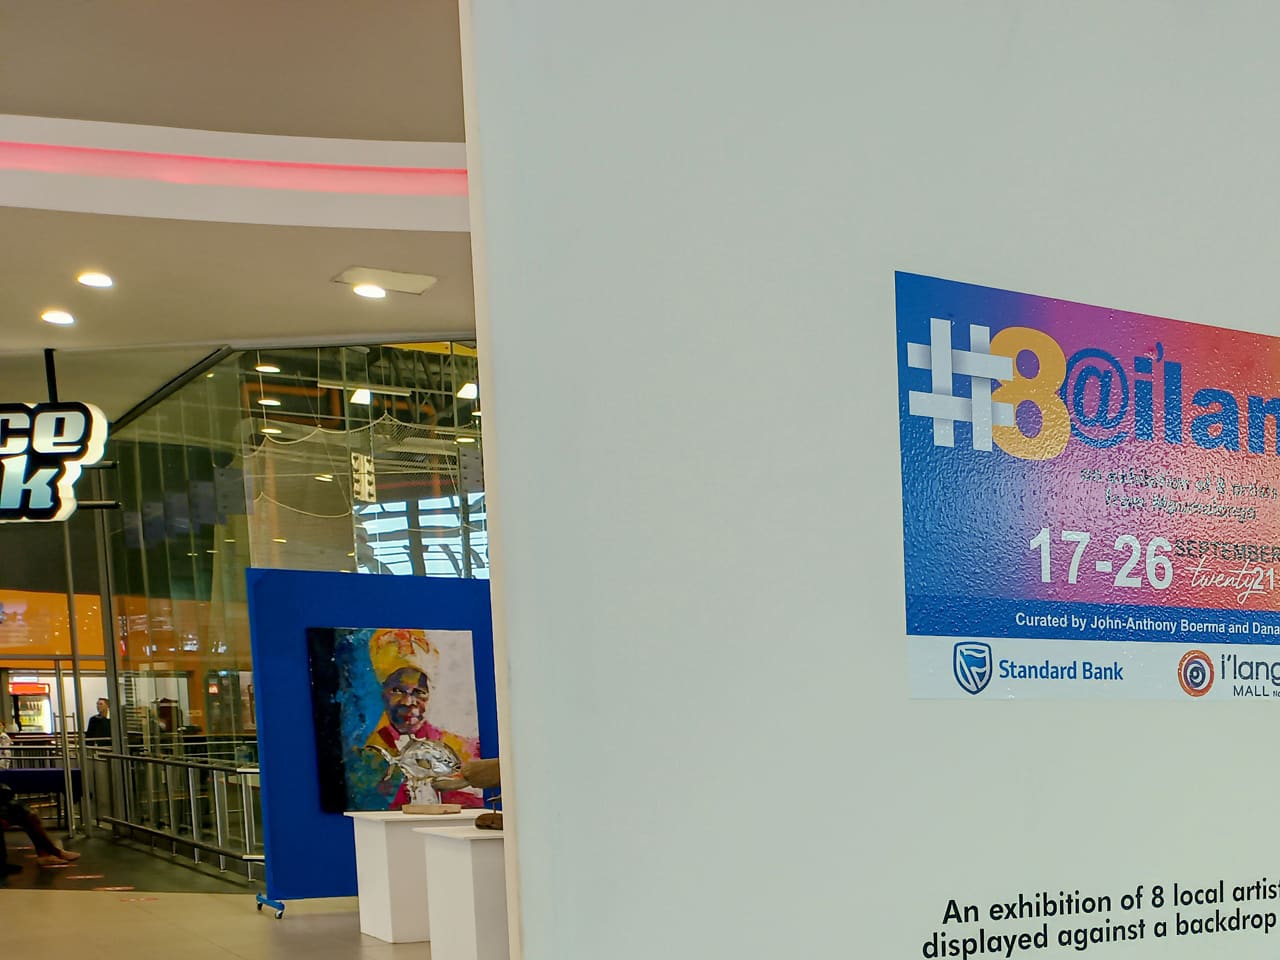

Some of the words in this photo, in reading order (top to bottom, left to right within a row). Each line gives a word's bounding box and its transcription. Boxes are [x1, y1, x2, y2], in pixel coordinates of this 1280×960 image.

[1029, 527, 1174, 590] 17-26
[1015, 612, 1068, 628] Curated
[1071, 615, 1087, 631] by
[1090, 616, 1178, 633] John-Anthony
[1180, 619, 1226, 634] Boerma
[1228, 622, 1250, 634] and
[1252, 622, 1280, 636] Dana
[999, 659, 1077, 680] Standard
[1082, 661, 1124, 681] Bank
[1233, 686, 1269, 697] MALL
[942, 899, 979, 925] An
[989, 890, 1112, 924] exhibition
[1120, 885, 1144, 911] of
[1151, 885, 1165, 909] 8
[1173, 879, 1224, 907] local
[1057, 918, 1146, 952] against
[1153, 921, 1167, 938] a
[1176, 907, 1277, 936] backdrop
